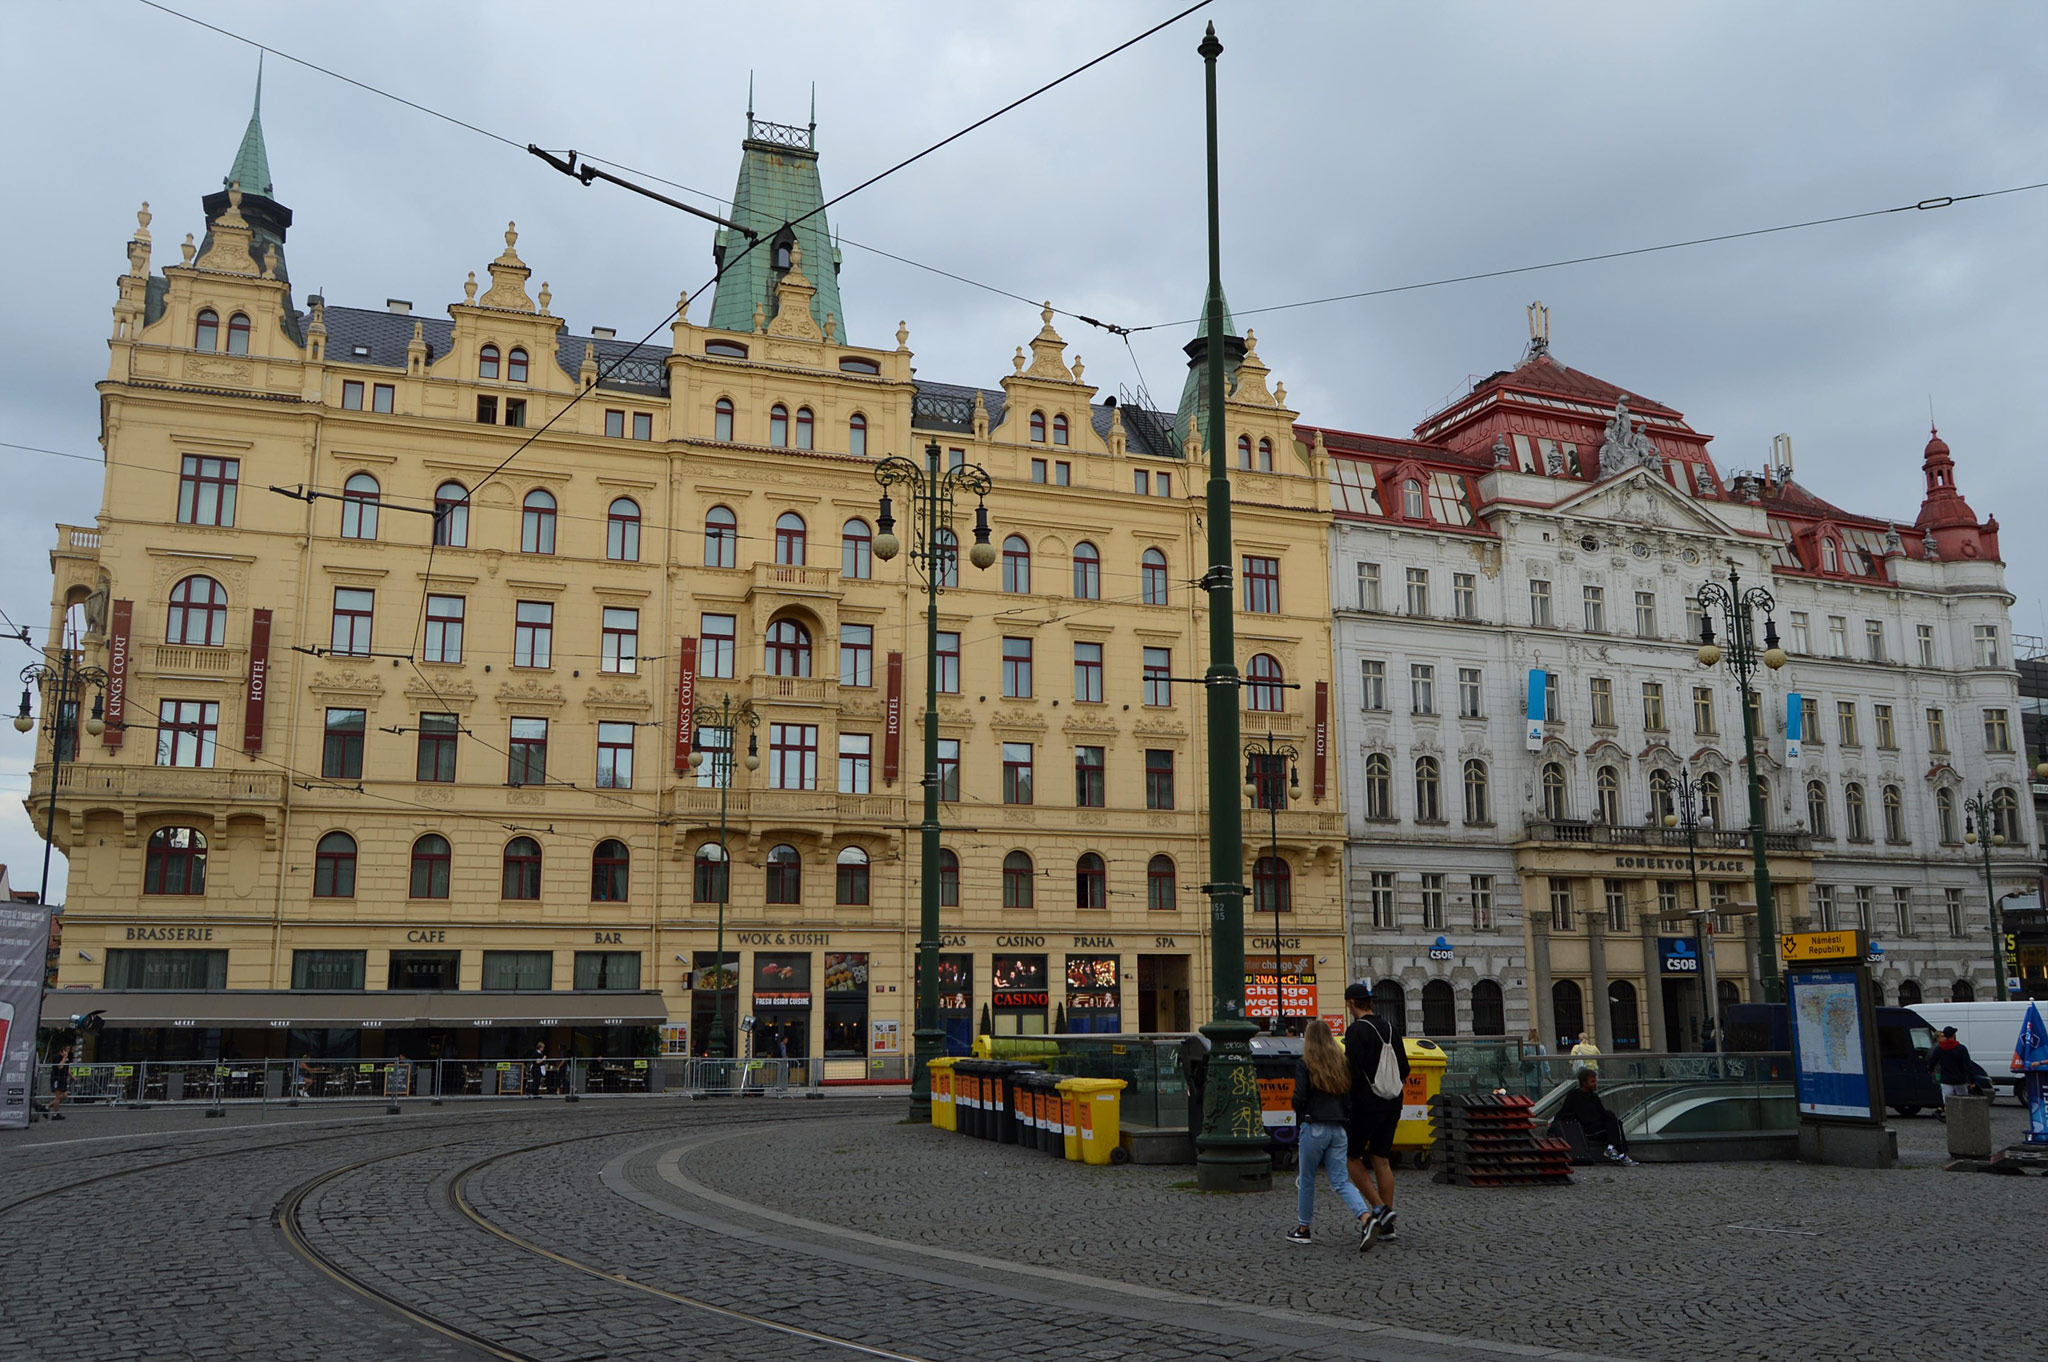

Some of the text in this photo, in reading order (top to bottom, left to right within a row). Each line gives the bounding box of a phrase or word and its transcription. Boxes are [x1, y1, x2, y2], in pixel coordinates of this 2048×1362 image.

[113, 635, 126, 675] COURT
[251, 658, 265, 701] HOTEL
[681, 669, 692, 705] COURT
[110, 677, 123, 716] KINGS
[888, 696, 899, 734] HOTEL
[680, 708, 691, 743] KINGS
[1316, 722, 1325, 756] HOTEL
[1700, 860, 1744, 872] PLACE
[126, 927, 213, 940] BRASSERIE
[407, 930, 446, 943] CAFE
[594, 932, 623, 944] BAR
[737, 933, 830, 945] WOK & SUSHI
[996, 936, 1045, 947] CASINO
[1074, 937, 1115, 948] PRAHA
[1155, 937, 1176, 948] SPA
[1252, 938, 1301, 949] CHANGE
[1811, 935, 1842, 945] Náměstí
[1808, 946, 1846, 955] Republiky
[1262, 960, 1293, 971] chage
[1666, 958, 1697, 970] ČSOB
[1246, 986, 1308, 997] change
[756, 997, 809, 1006] FRESH ASIAN CUISINE
[994, 993, 1049, 1006] CASINO
[1245, 997, 1313, 1007] wechsel
